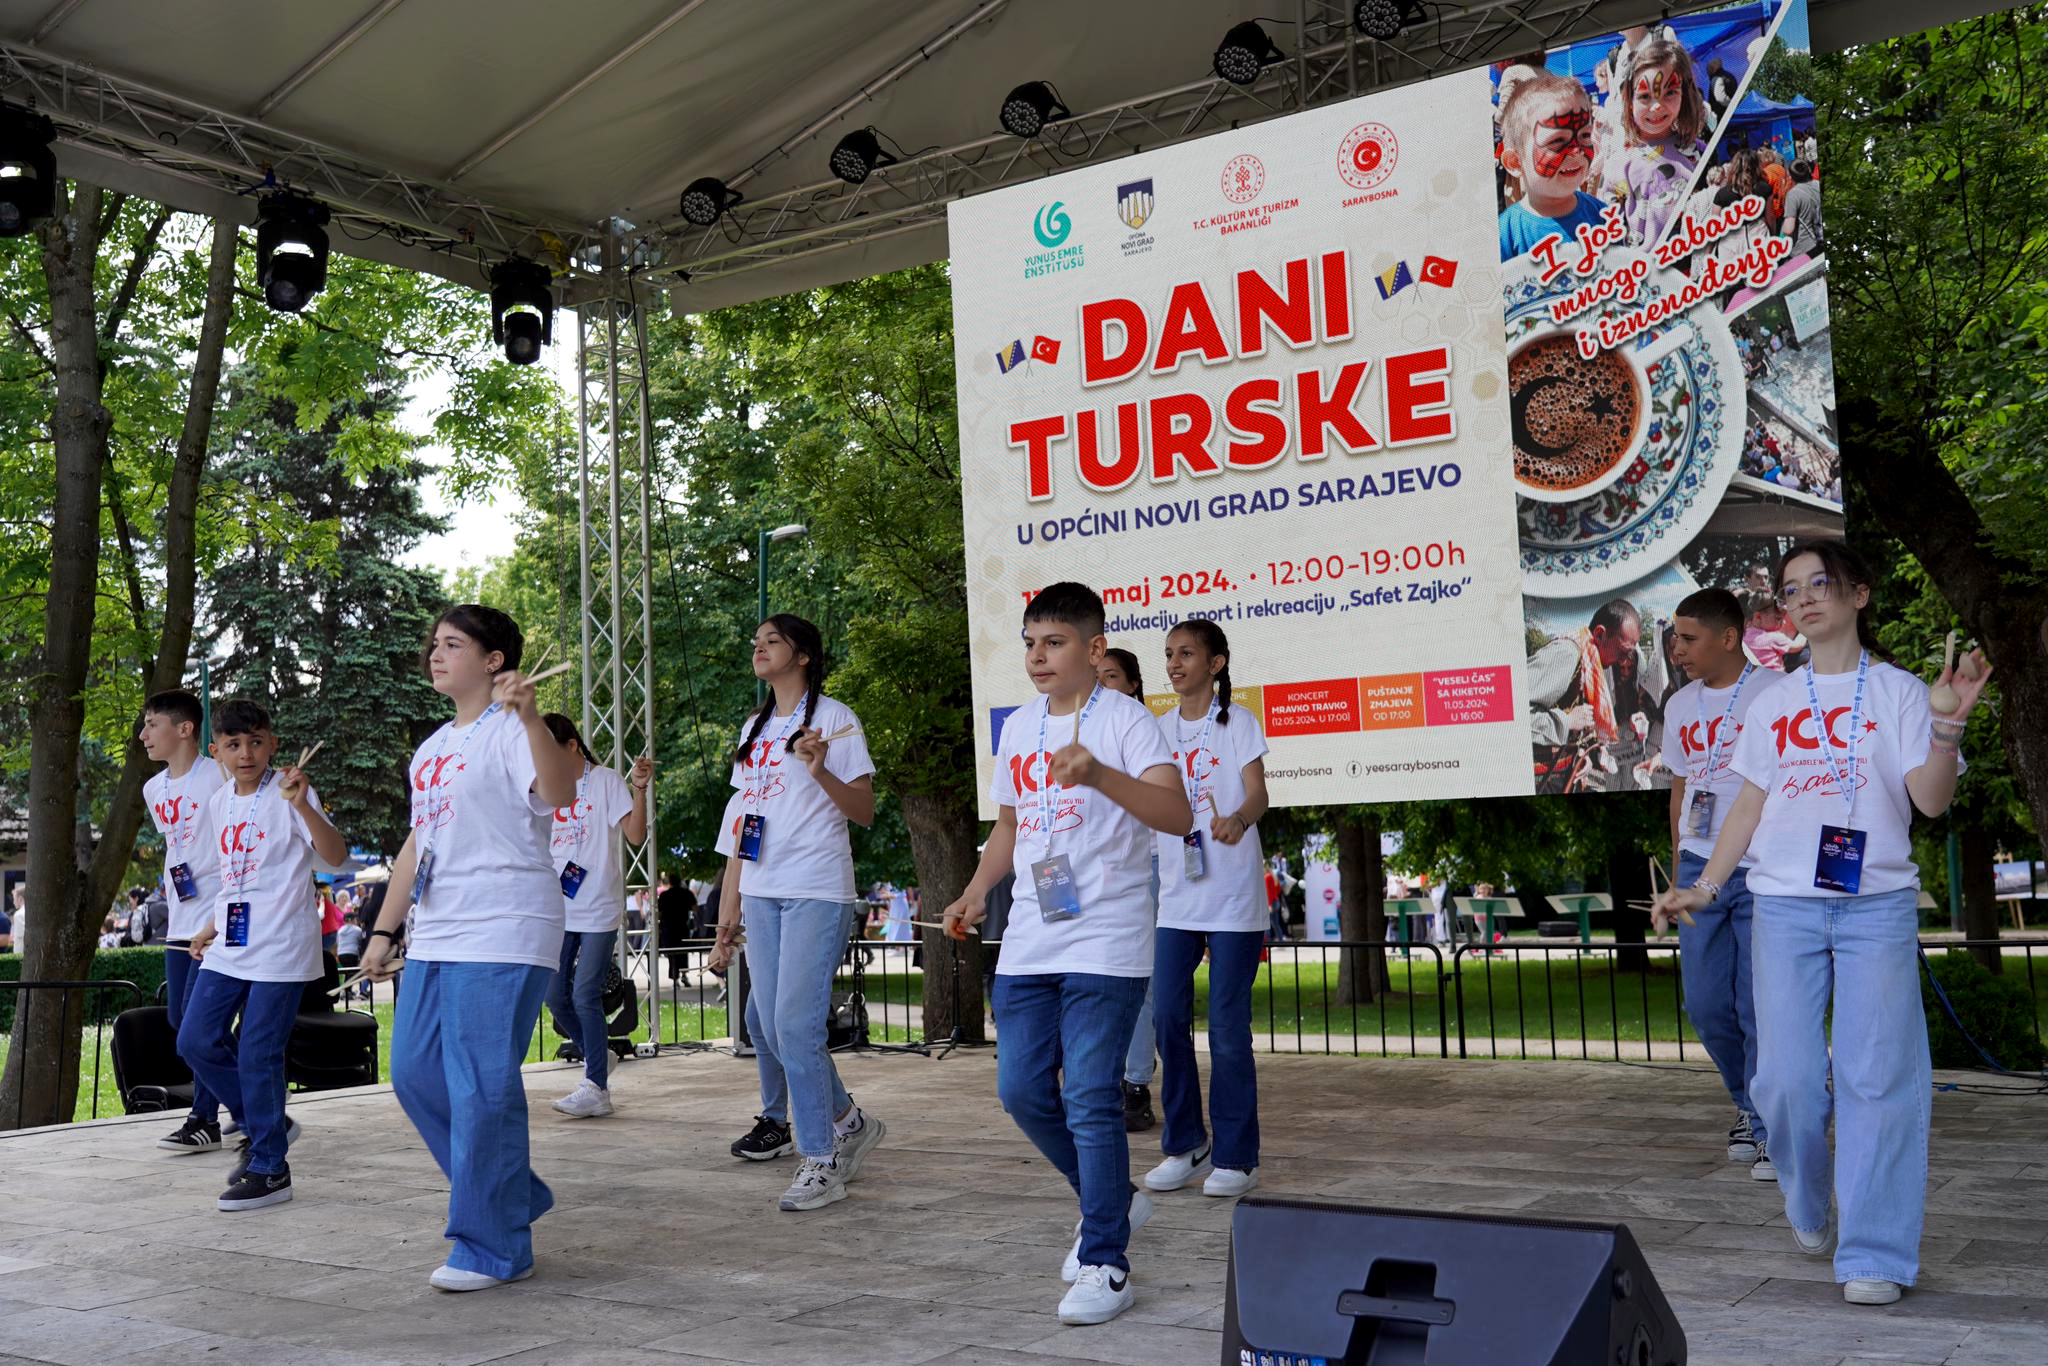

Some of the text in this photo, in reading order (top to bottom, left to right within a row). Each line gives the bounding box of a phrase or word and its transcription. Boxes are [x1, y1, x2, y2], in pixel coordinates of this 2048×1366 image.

[1341, 188, 1399, 208] SARAYBOSNA
[1193, 198, 1300, 230] T.C. KÜLTÜR VE TURİZM
[1220, 215, 1272, 236] BAKANLIĞI
[1121, 236, 1155, 250] NOVI GRAD
[1124, 246, 1153, 257] SARAJEVO
[1532, 206, 1624, 282] I još
[1025, 245, 1083, 267] YUNUS EMRE
[1552, 198, 1762, 322] mnogo zabave
[1577, 330, 1596, 357] i
[1599, 238, 1790, 346] iznenađenja
[1081, 250, 1349, 383] DANI
[1010, 348, 1452, 497] TURSKE
[1017, 463, 1462, 545] U OPĆINI NOVI GRAD SARAJEVO
[1103, 577, 1150, 607] maj
[1160, 569, 1238, 599] 2024.
[1237, 602, 1242, 619] i
[1246, 594, 1335, 620] rekreaciju
[1288, 691, 1329, 702] KONCERT
[1368, 686, 1414, 697] PUŠTANJE
[1437, 686, 1495, 698] SA KIKETOM
[1271, 701, 1348, 714] MRAVKO TRAVKO
[1370, 698, 1414, 709] ZMAJEVA
[1373, 711, 1411, 721] OD 17:00
[1365, 759, 1460, 774] yeesaraybosnaa
